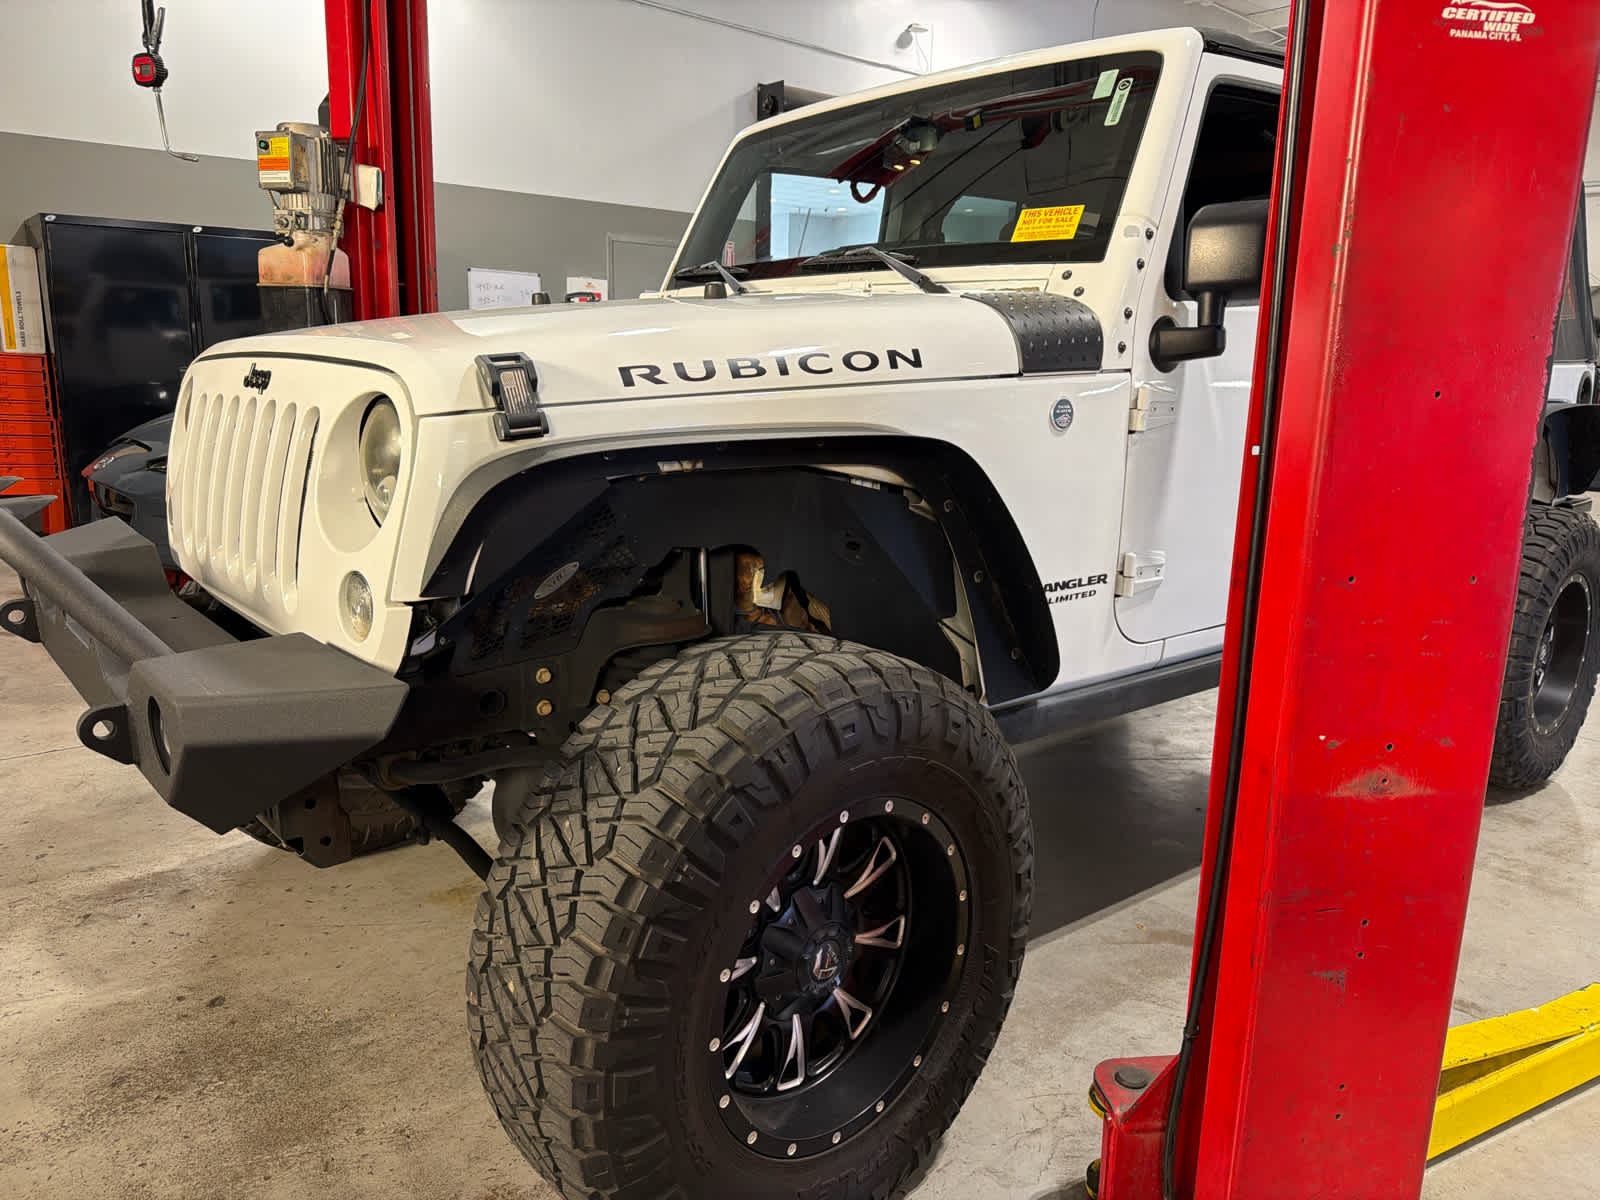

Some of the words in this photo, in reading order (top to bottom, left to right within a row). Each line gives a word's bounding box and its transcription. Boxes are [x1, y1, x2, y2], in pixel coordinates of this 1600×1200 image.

[1441, 7, 1536, 24] CERTIFIED
[1483, 21, 1519, 33] WIDE
[1449, 29, 1488, 40] PANAMA
[1488, 32, 1510, 42] CITY,
[1510, 33, 1522, 42] FL
[1023, 210, 1041, 218] THIS
[1044, 207, 1079, 217] VEHICLE
[1038, 217, 1052, 225] FOR
[617, 348, 924, 388] RUBICON
[243, 362, 272, 395] Jeep
[1043, 573, 1108, 593] ANGLER
[1048, 589, 1097, 605] LIMITED
